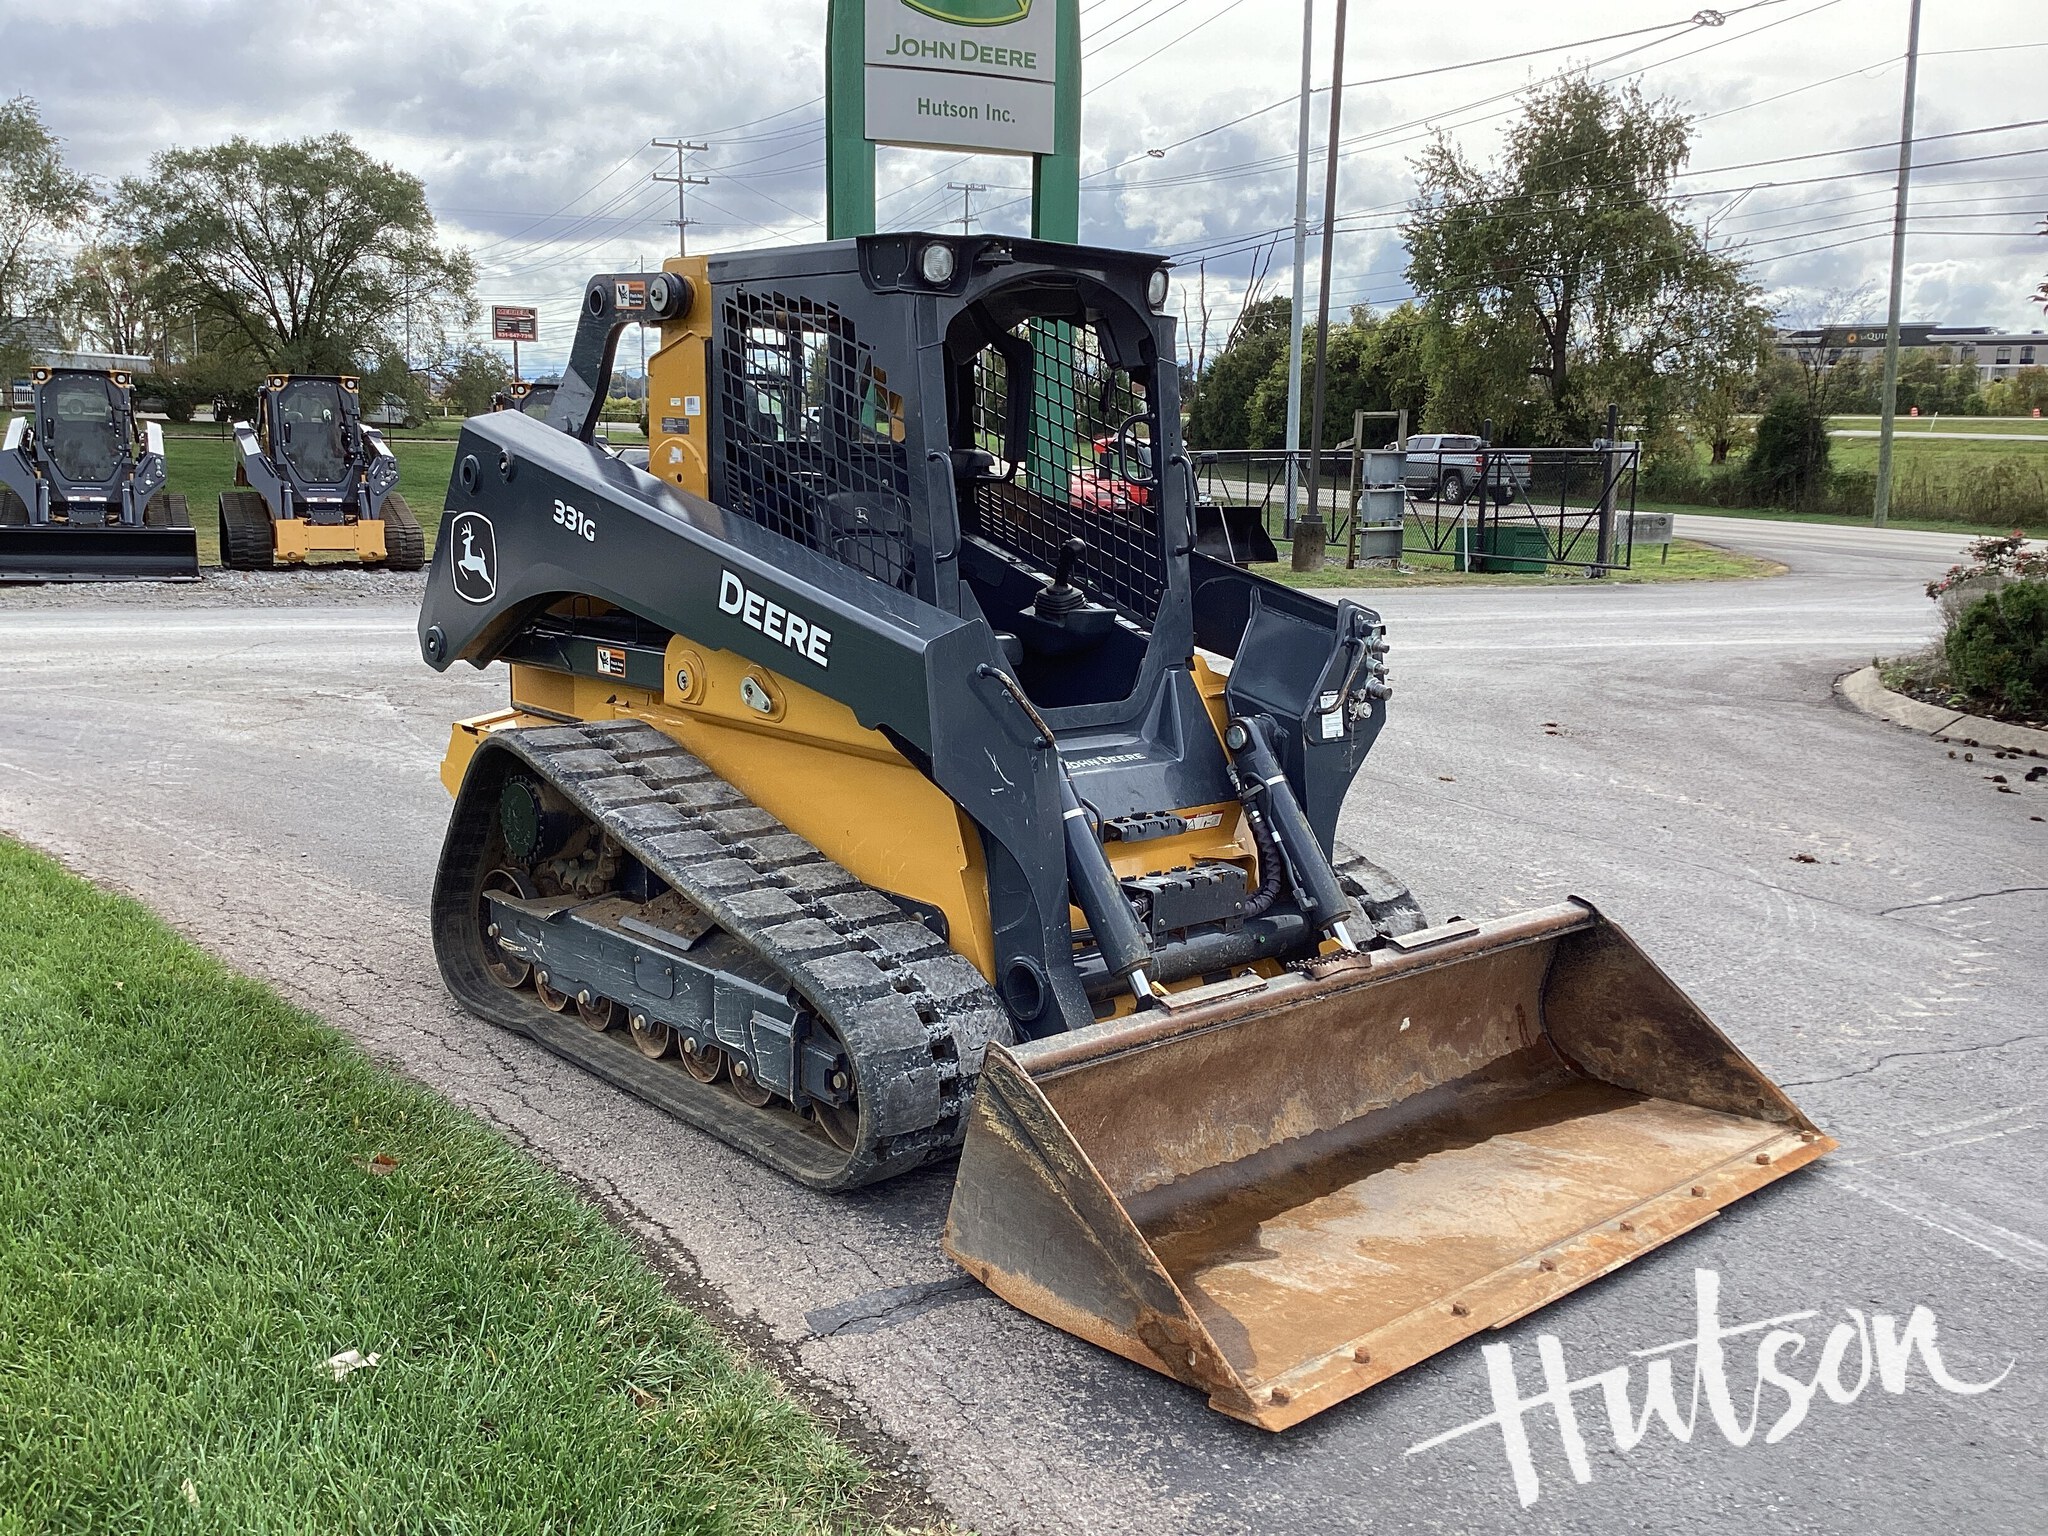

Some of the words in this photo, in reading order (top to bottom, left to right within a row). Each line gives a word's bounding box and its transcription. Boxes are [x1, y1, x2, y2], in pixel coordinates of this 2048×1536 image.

[886, 34, 956, 60] JOHN
[960, 39, 1037, 70] DEERE
[917, 97, 979, 120] Hutson
[986, 103, 1016, 123] Inc.
[553, 499, 596, 542] 331G
[719, 569, 832, 668] DEERE
[1097, 752, 1147, 765] DEERE
